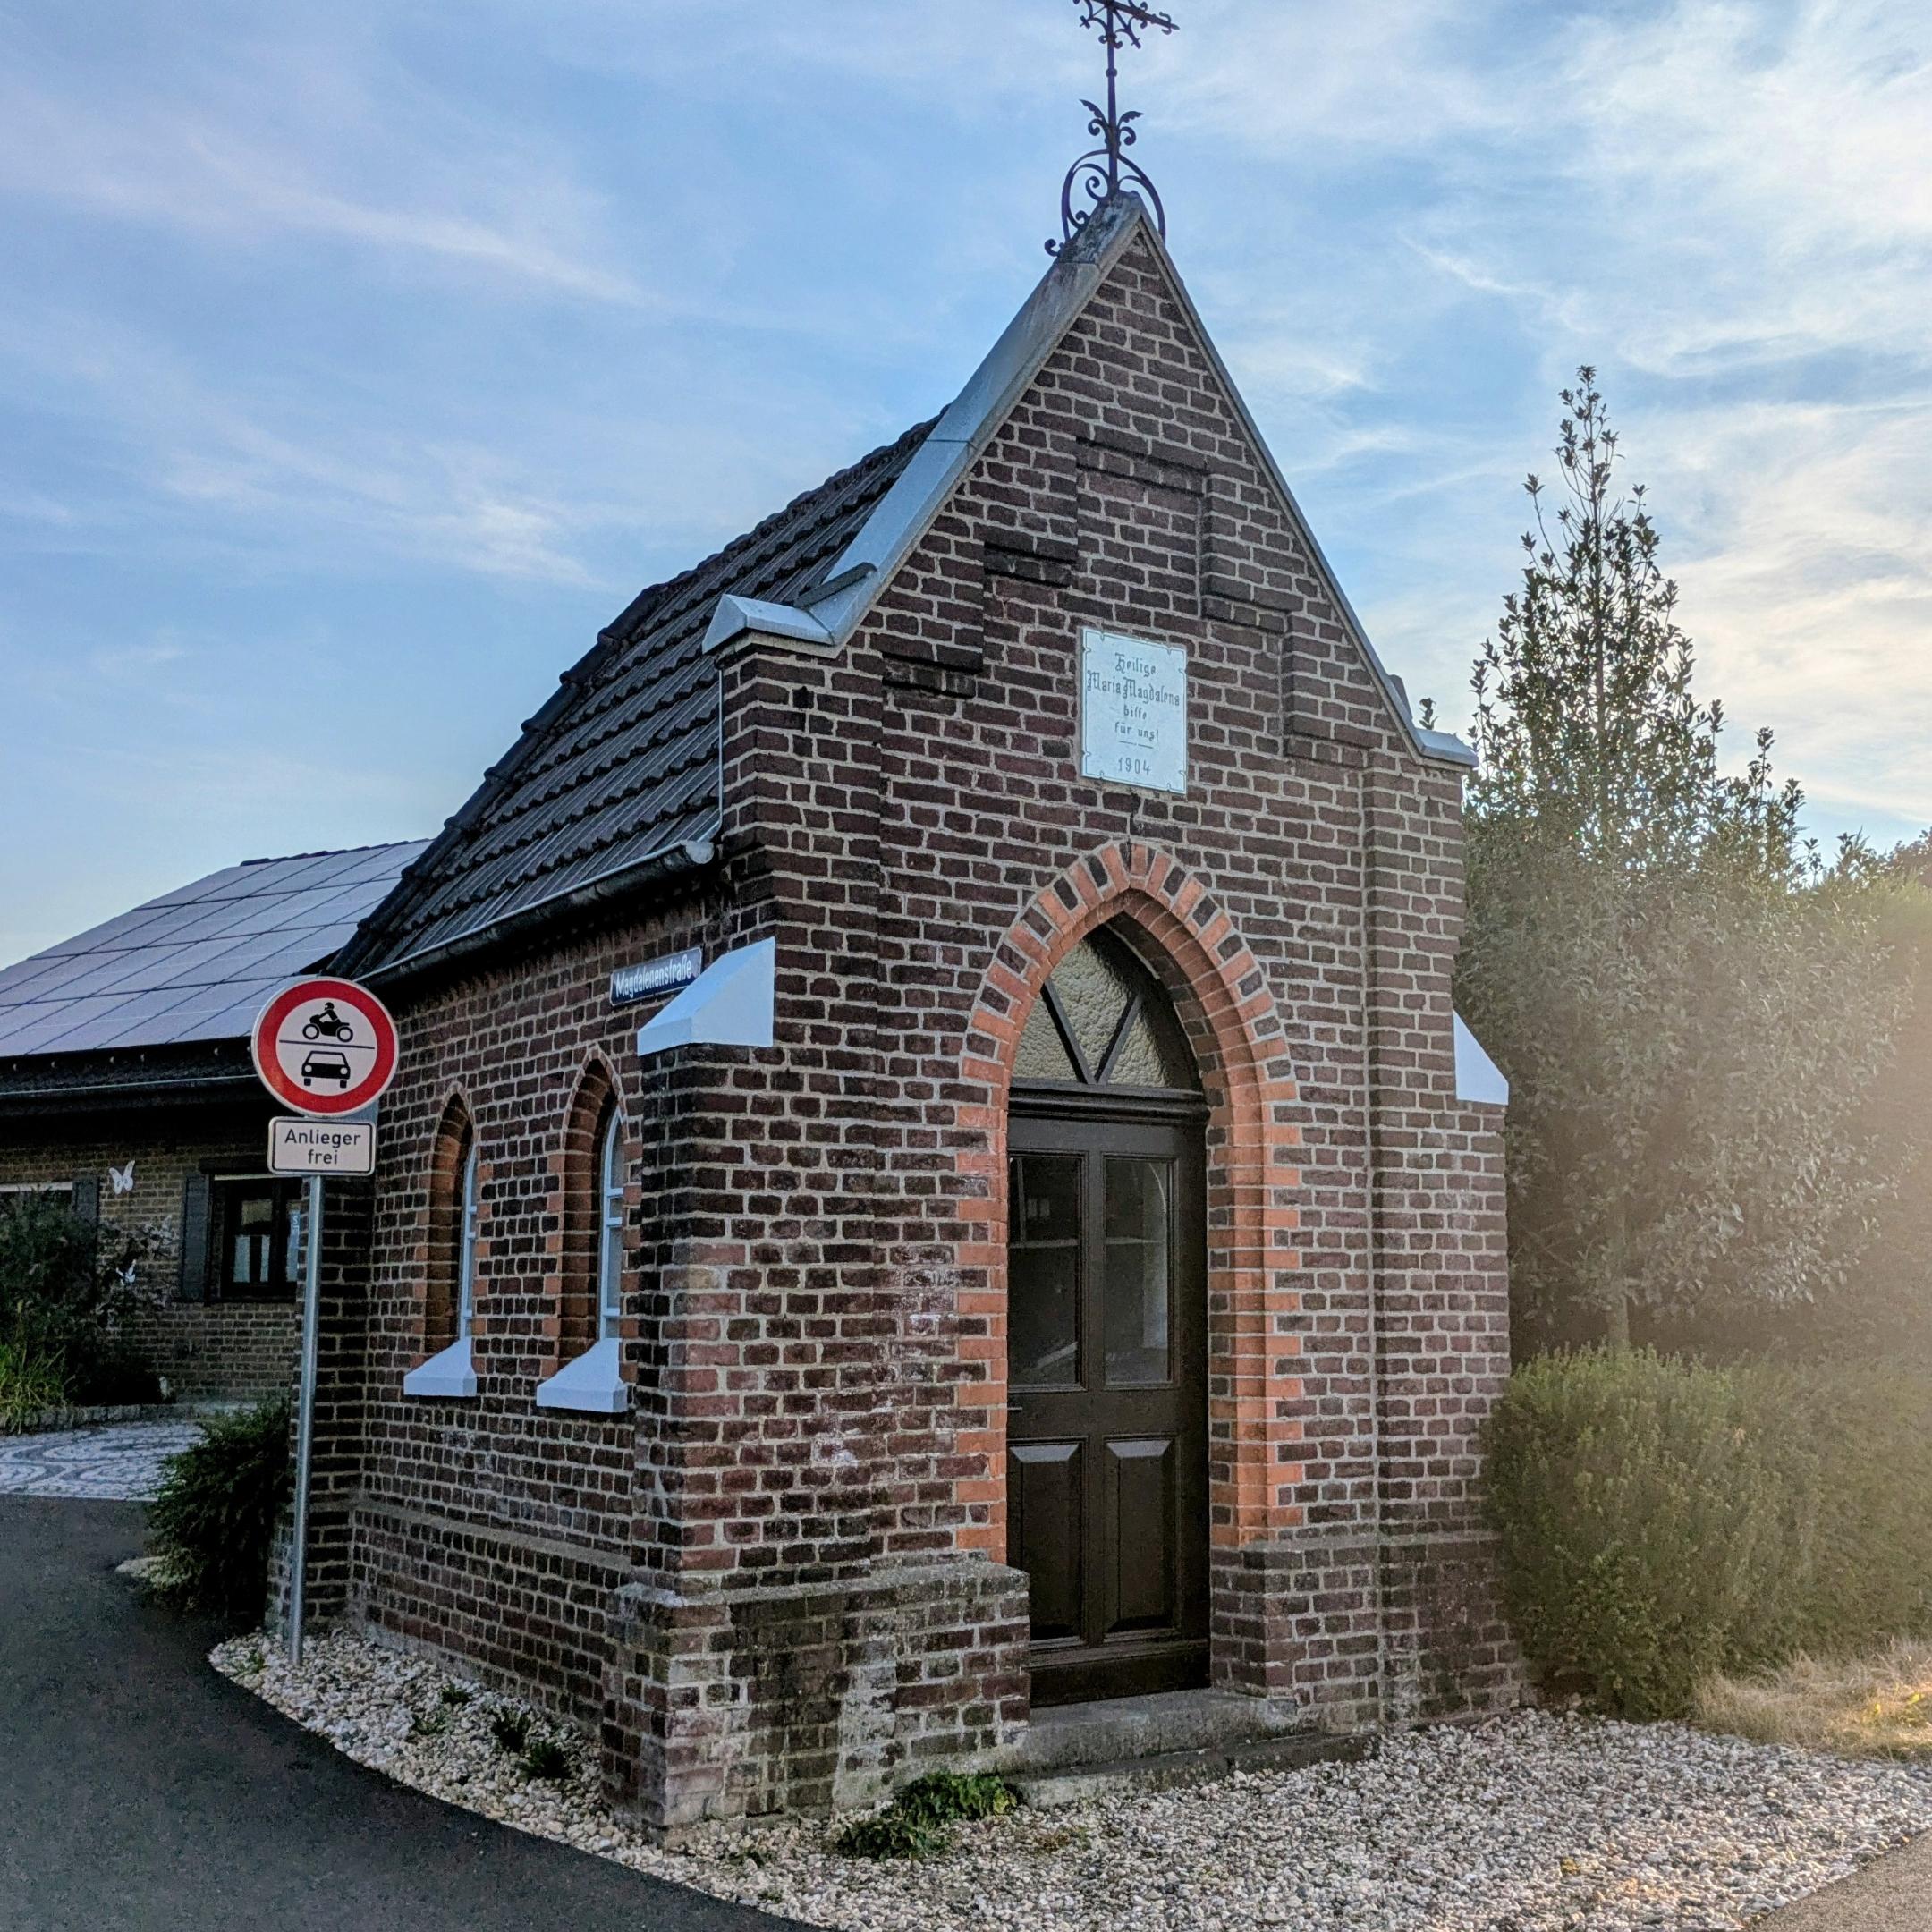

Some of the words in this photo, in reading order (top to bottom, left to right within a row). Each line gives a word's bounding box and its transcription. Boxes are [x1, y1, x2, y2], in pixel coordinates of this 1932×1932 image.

[1114, 653, 1157, 677] Heilige
[1087, 670, 1121, 694] Maria
[1122, 677, 1180, 706] Magdalena
[1114, 721, 1132, 735] für
[1118, 758, 1151, 776] 1904
[615, 953, 691, 999] Magdalenenstraße
[284, 1128, 361, 1148] Anlieger
[308, 1149, 338, 1165] frei
